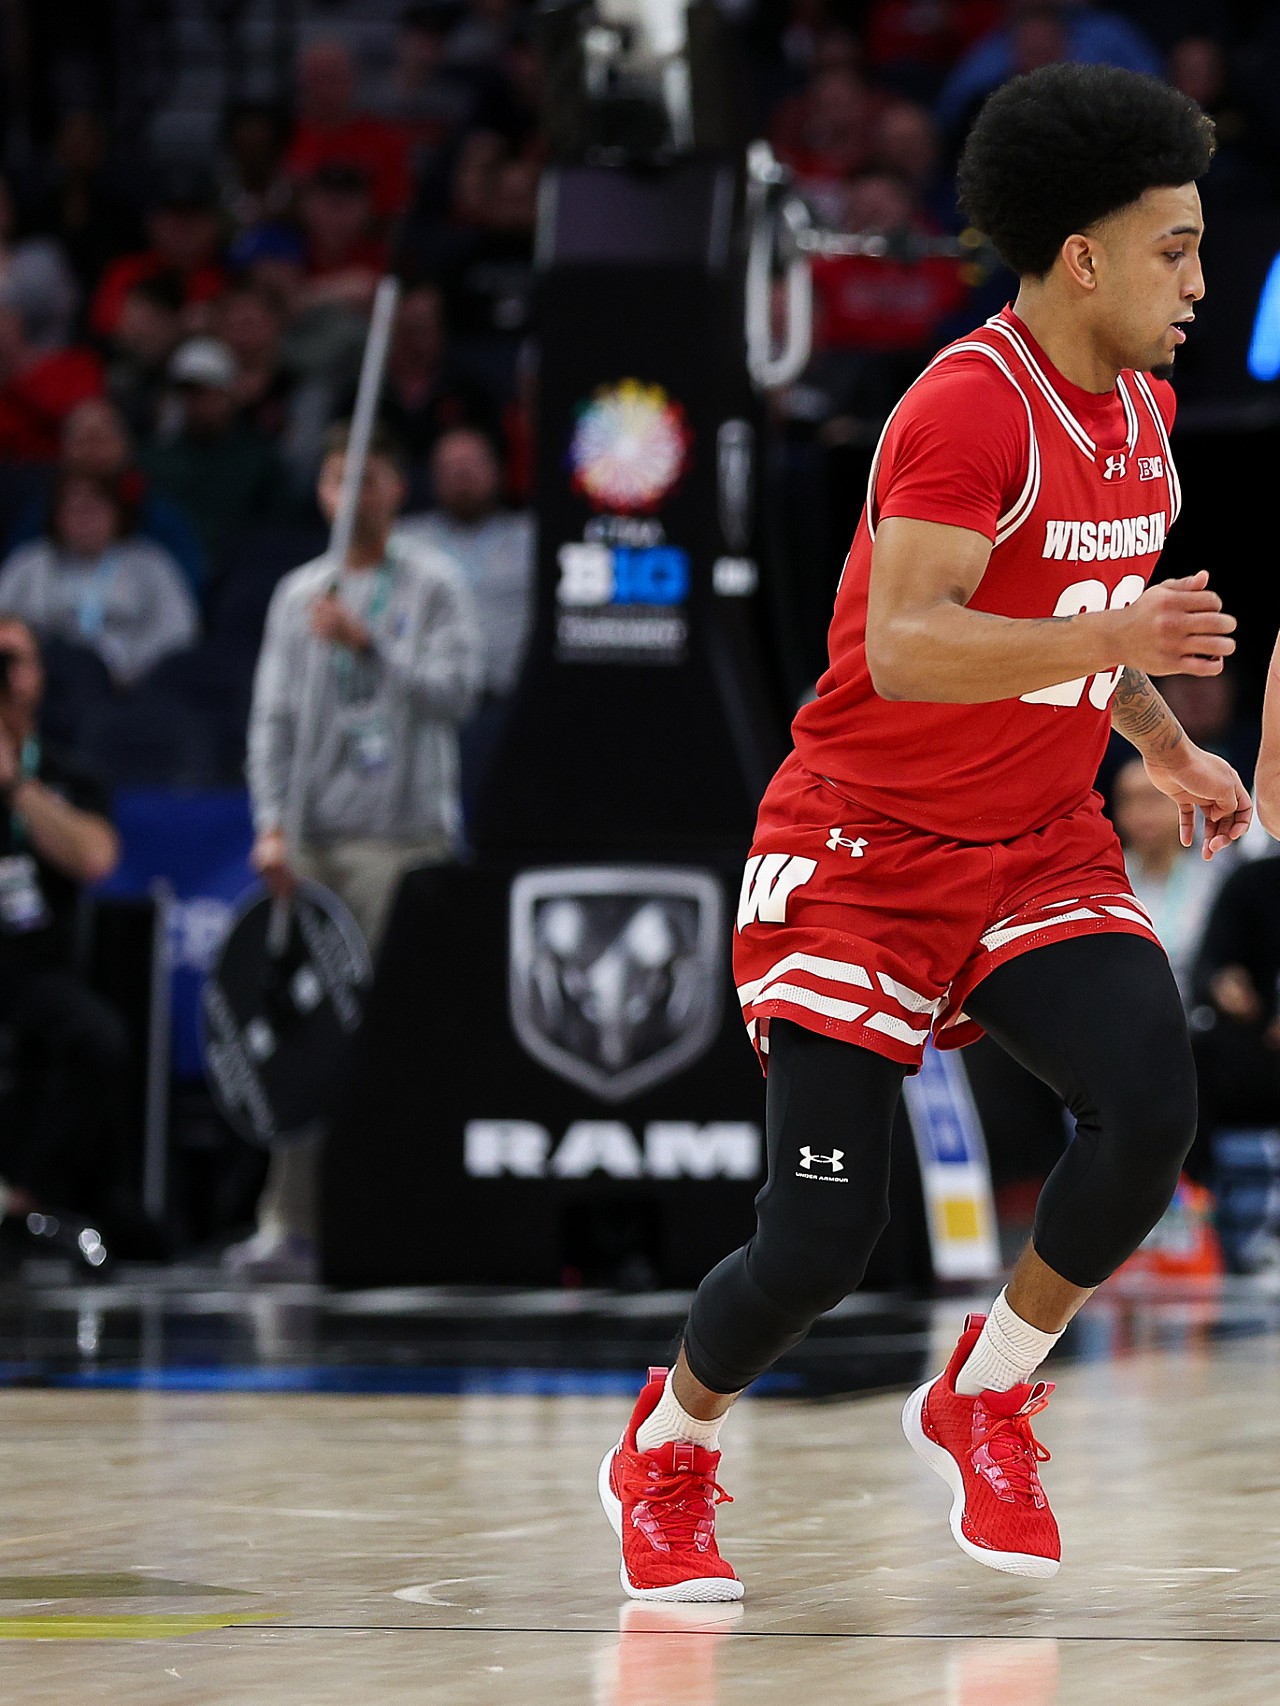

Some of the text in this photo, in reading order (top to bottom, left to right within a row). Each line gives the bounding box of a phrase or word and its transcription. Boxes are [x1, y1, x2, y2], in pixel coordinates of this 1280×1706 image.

[1041, 511, 1166, 562] WISCONSIN
[736, 852, 818, 935] W
[463, 1118, 762, 1180] RAM
